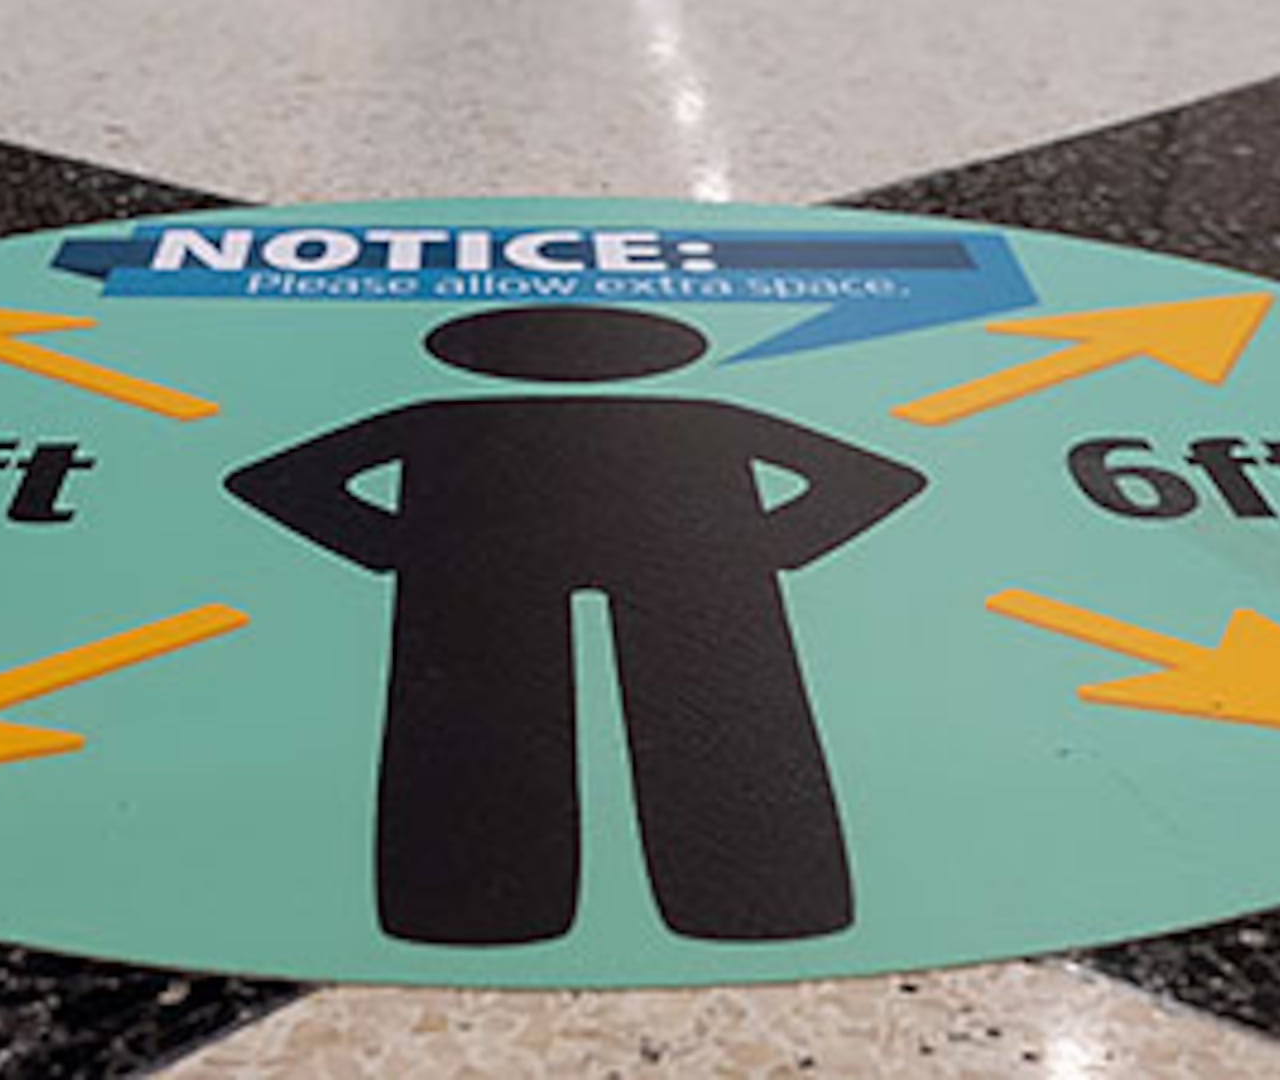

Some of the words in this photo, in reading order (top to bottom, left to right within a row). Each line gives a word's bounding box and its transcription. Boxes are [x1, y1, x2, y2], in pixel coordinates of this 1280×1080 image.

[150, 227, 718, 273] NOTICE:
[246, 272, 419, 296] Please
[433, 272, 581, 296] allow
[594, 273, 733, 297] extra
[745, 275, 914, 299] space.
